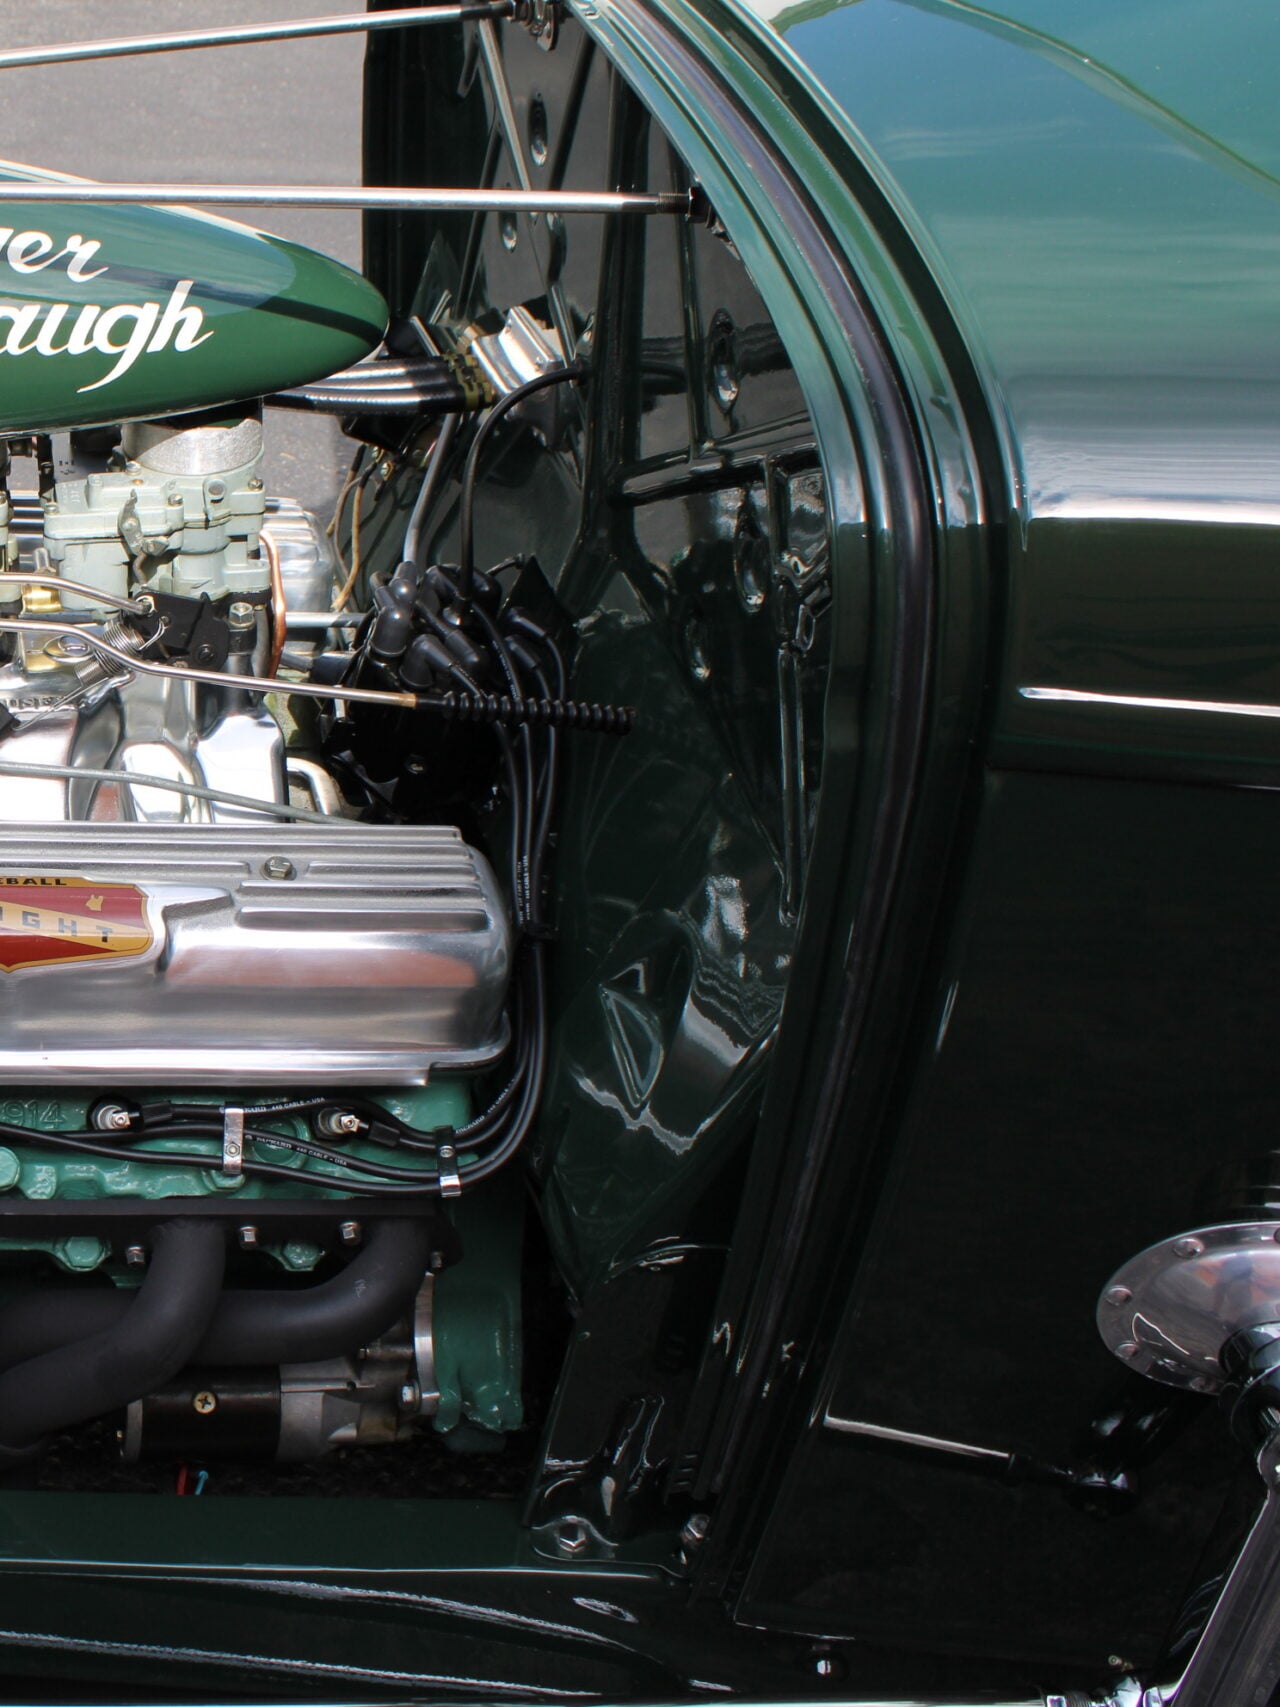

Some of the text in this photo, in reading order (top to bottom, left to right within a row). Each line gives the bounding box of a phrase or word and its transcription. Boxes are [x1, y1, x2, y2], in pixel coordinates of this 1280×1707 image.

[284, 1099, 304, 1108] CABLE
[308, 1149, 328, 1159] CABLE
[334, 1157, 348, 1166] USA
